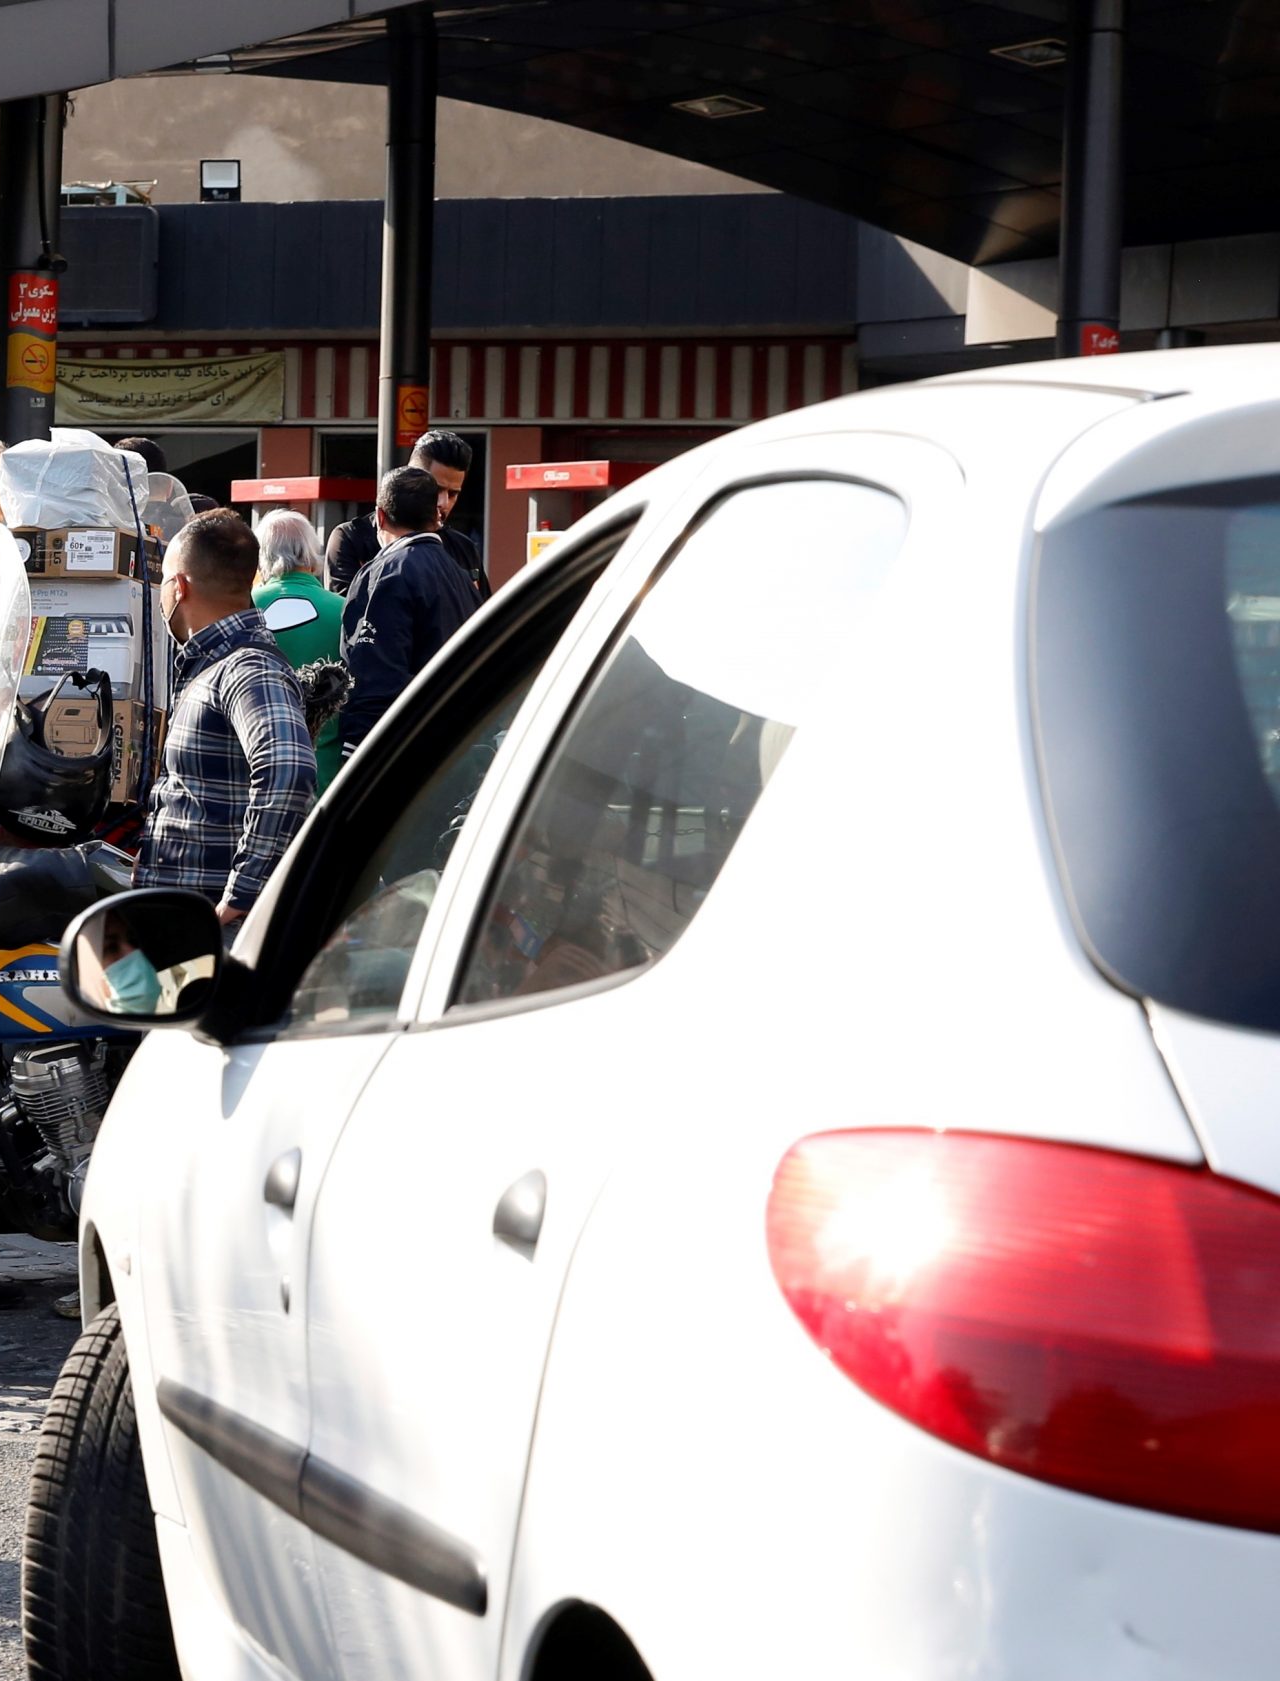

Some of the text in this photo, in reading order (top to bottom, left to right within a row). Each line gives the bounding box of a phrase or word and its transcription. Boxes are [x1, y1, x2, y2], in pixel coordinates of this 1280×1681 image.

[11, 301, 40, 322] معمولی
[70, 367, 86, 383] غیر
[197, 366, 229, 380] جایگاه
[69, 541, 84, 550] 409
[53, 551, 62, 564] LG
